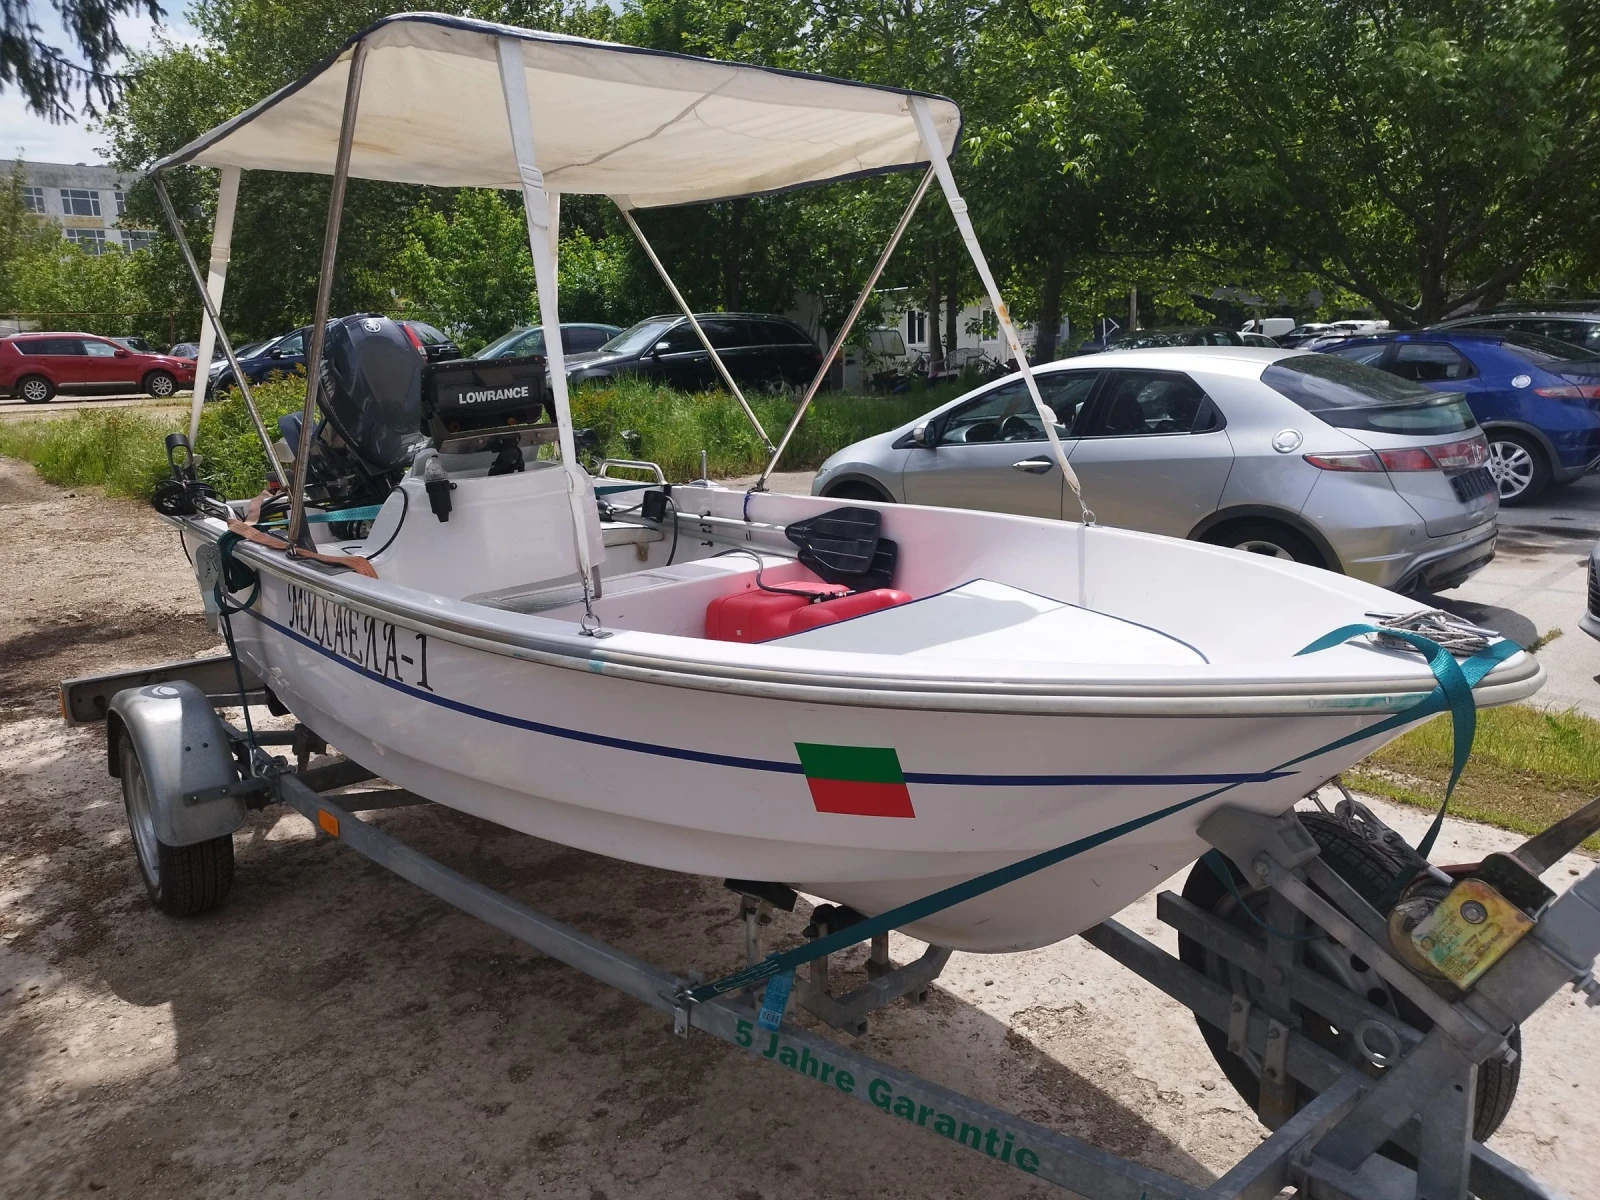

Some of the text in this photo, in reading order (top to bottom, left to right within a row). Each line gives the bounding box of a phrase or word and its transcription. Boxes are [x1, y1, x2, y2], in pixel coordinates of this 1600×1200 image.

[319, 357, 335, 399] AMAHA
[458, 386, 529, 405] LOWRANCE
[287, 583, 434, 692] МИХАЕЛА-1
[734, 1019, 1041, 1175] 5 Jahre Garantie
